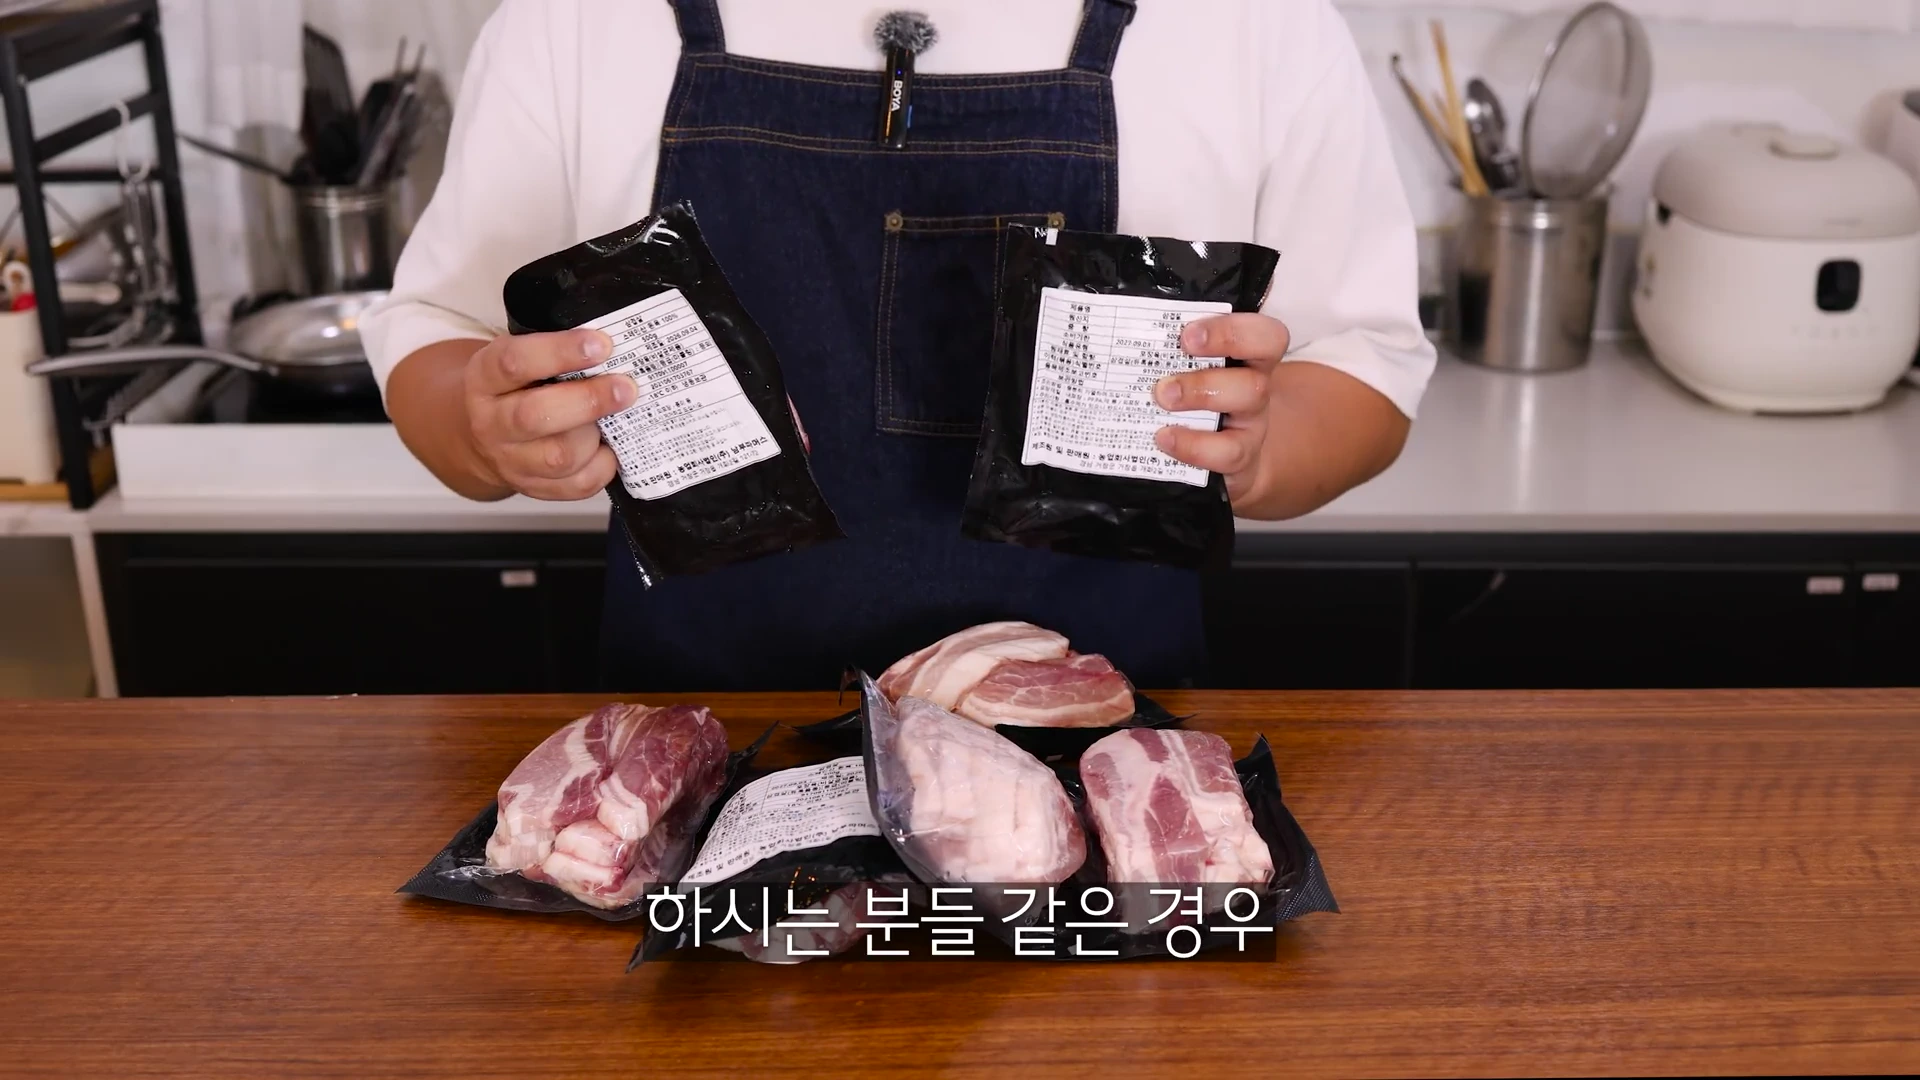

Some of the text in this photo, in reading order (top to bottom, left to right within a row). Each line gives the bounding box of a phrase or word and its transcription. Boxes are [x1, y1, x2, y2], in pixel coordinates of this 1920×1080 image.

[891, 80, 903, 111] BOYA
[661, 313, 679, 324] 100%
[641, 332, 658, 343] 500g
[606, 351, 637, 369] 2027.09.03
[1066, 448, 1090, 460] 판매원
